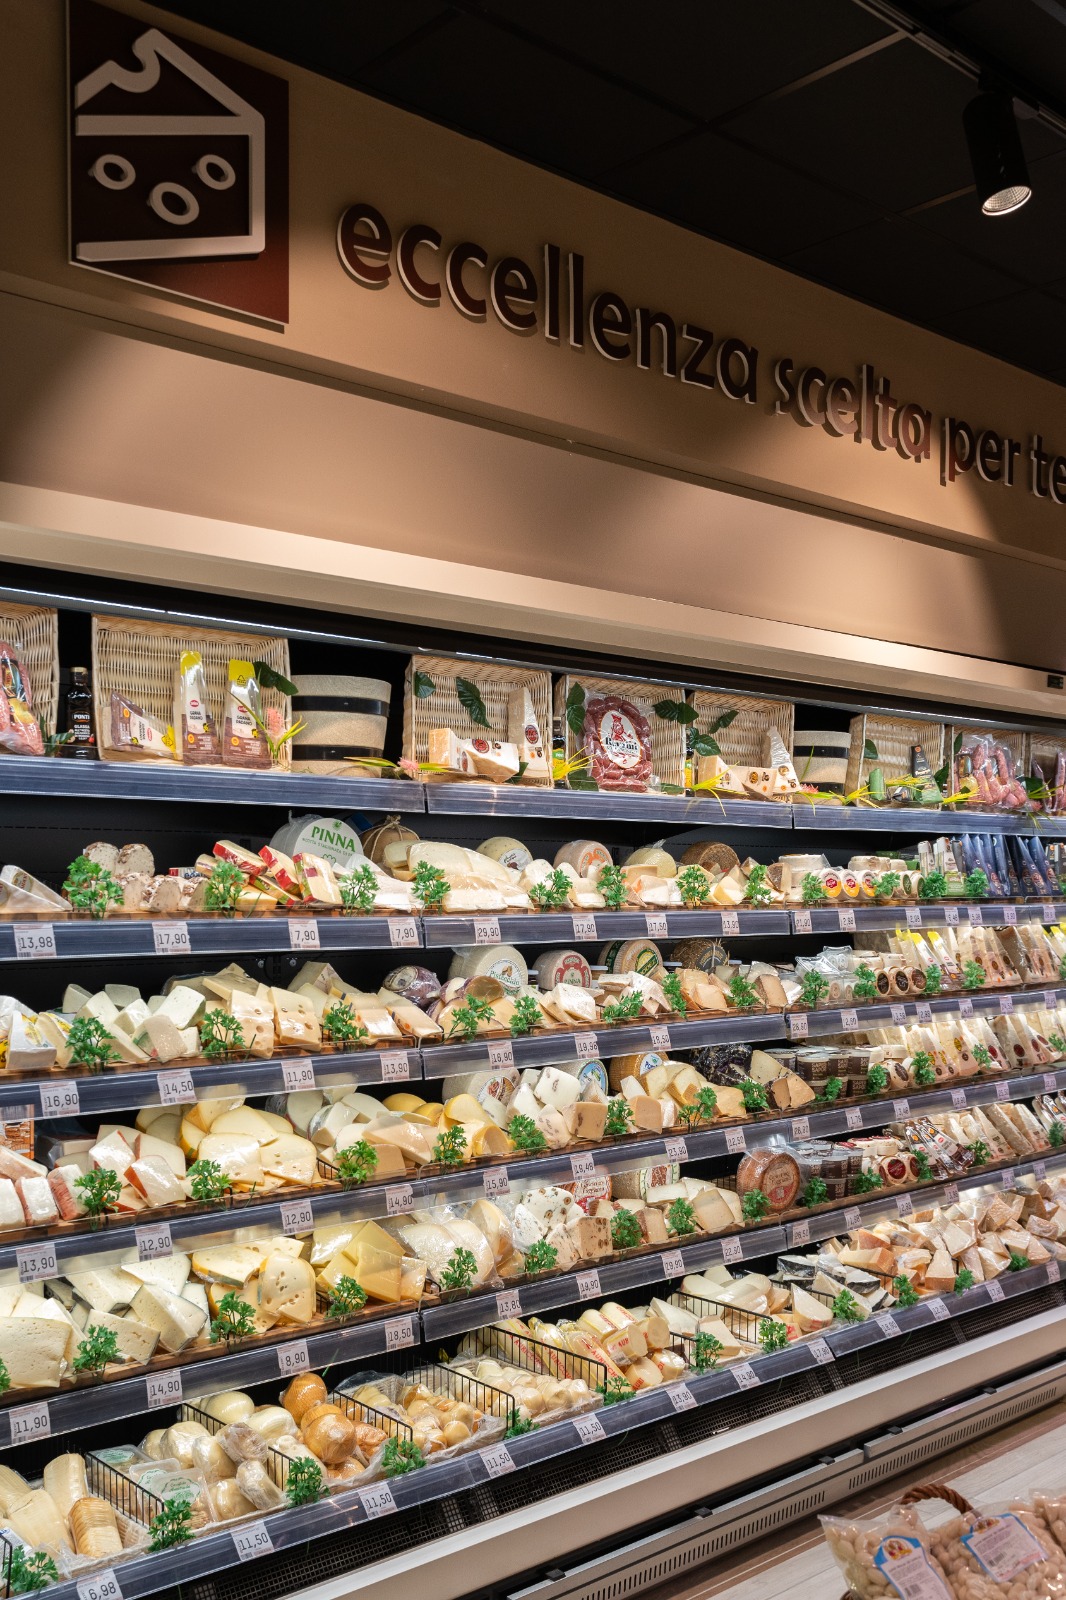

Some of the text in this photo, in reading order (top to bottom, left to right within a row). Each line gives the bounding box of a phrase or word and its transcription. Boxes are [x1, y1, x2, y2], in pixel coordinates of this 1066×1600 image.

[336, 202, 760, 406] eccellenza
[773, 357, 933, 464] scelta
[942, 416, 1020, 486] per
[311, 825, 356, 853] PINNA
[158, 933, 186, 946] 17,90
[295, 930, 316, 941] 7,90
[396, 927, 415, 939] 7,90
[478, 927, 499, 937] 29,90
[20, 936, 53, 949] 13,98
[385, 1062, 408, 1074] 13,90
[287, 1070, 312, 1083] 11,90
[165, 1080, 193, 1094] 14,50
[46, 1093, 78, 1108] 16,90
[487, 1177, 508, 1190] 15,90
[390, 1194, 413, 1208] 14,90
[286, 1211, 312, 1226] 12,90
[142, 1237, 171, 1251] 12,90
[23, 1257, 55, 1273] 13,90
[389, 1327, 411, 1342] 18,50
[285, 1352, 306, 1367] 8,90
[152, 1380, 180, 1397] 14,90
[16, 1415, 48, 1434] 11,90
[580, 1422, 602, 1436] 11,50
[489, 1452, 511, 1469] 11,50
[366, 1493, 392, 1509] 11,50
[239, 1532, 269, 1551] 11,50
[88, 1581, 116, 1600] 6,98
